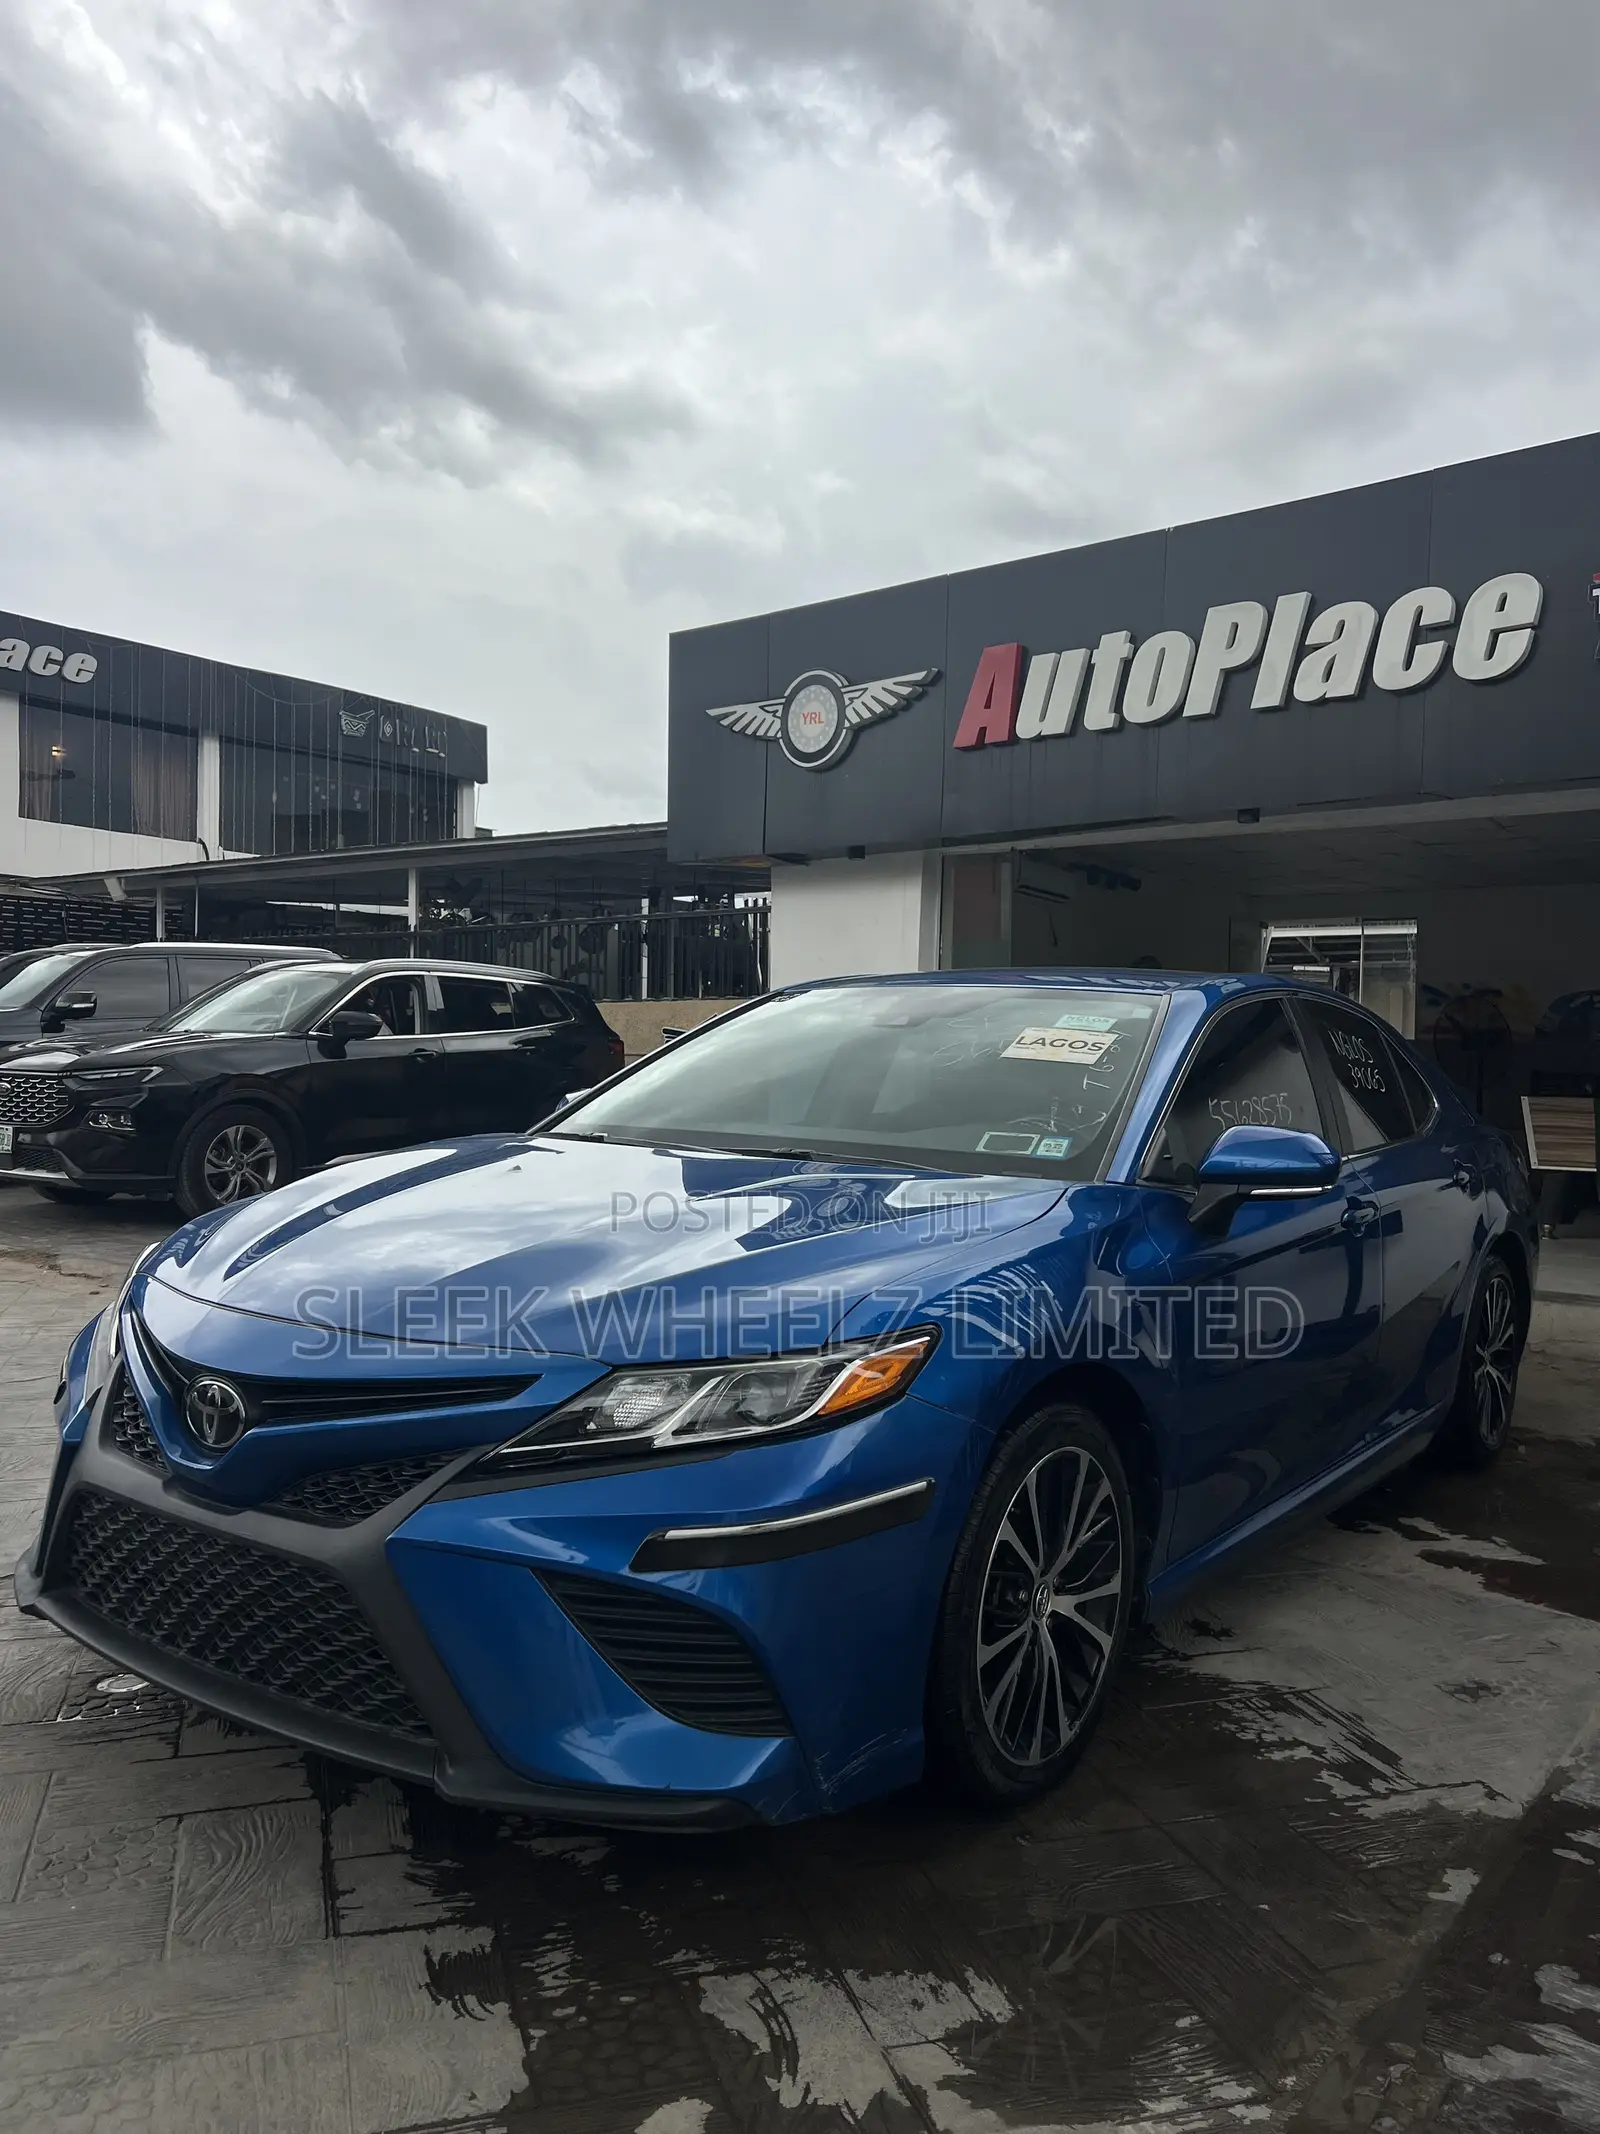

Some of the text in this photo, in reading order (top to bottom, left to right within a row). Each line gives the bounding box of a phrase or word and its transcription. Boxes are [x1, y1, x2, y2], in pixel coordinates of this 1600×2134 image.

[0, 638, 98, 684] ace
[953, 572, 1543, 750] AutoPlace
[801, 711, 825, 726] YRL
[1015, 1035, 1107, 1052] LAGOS
